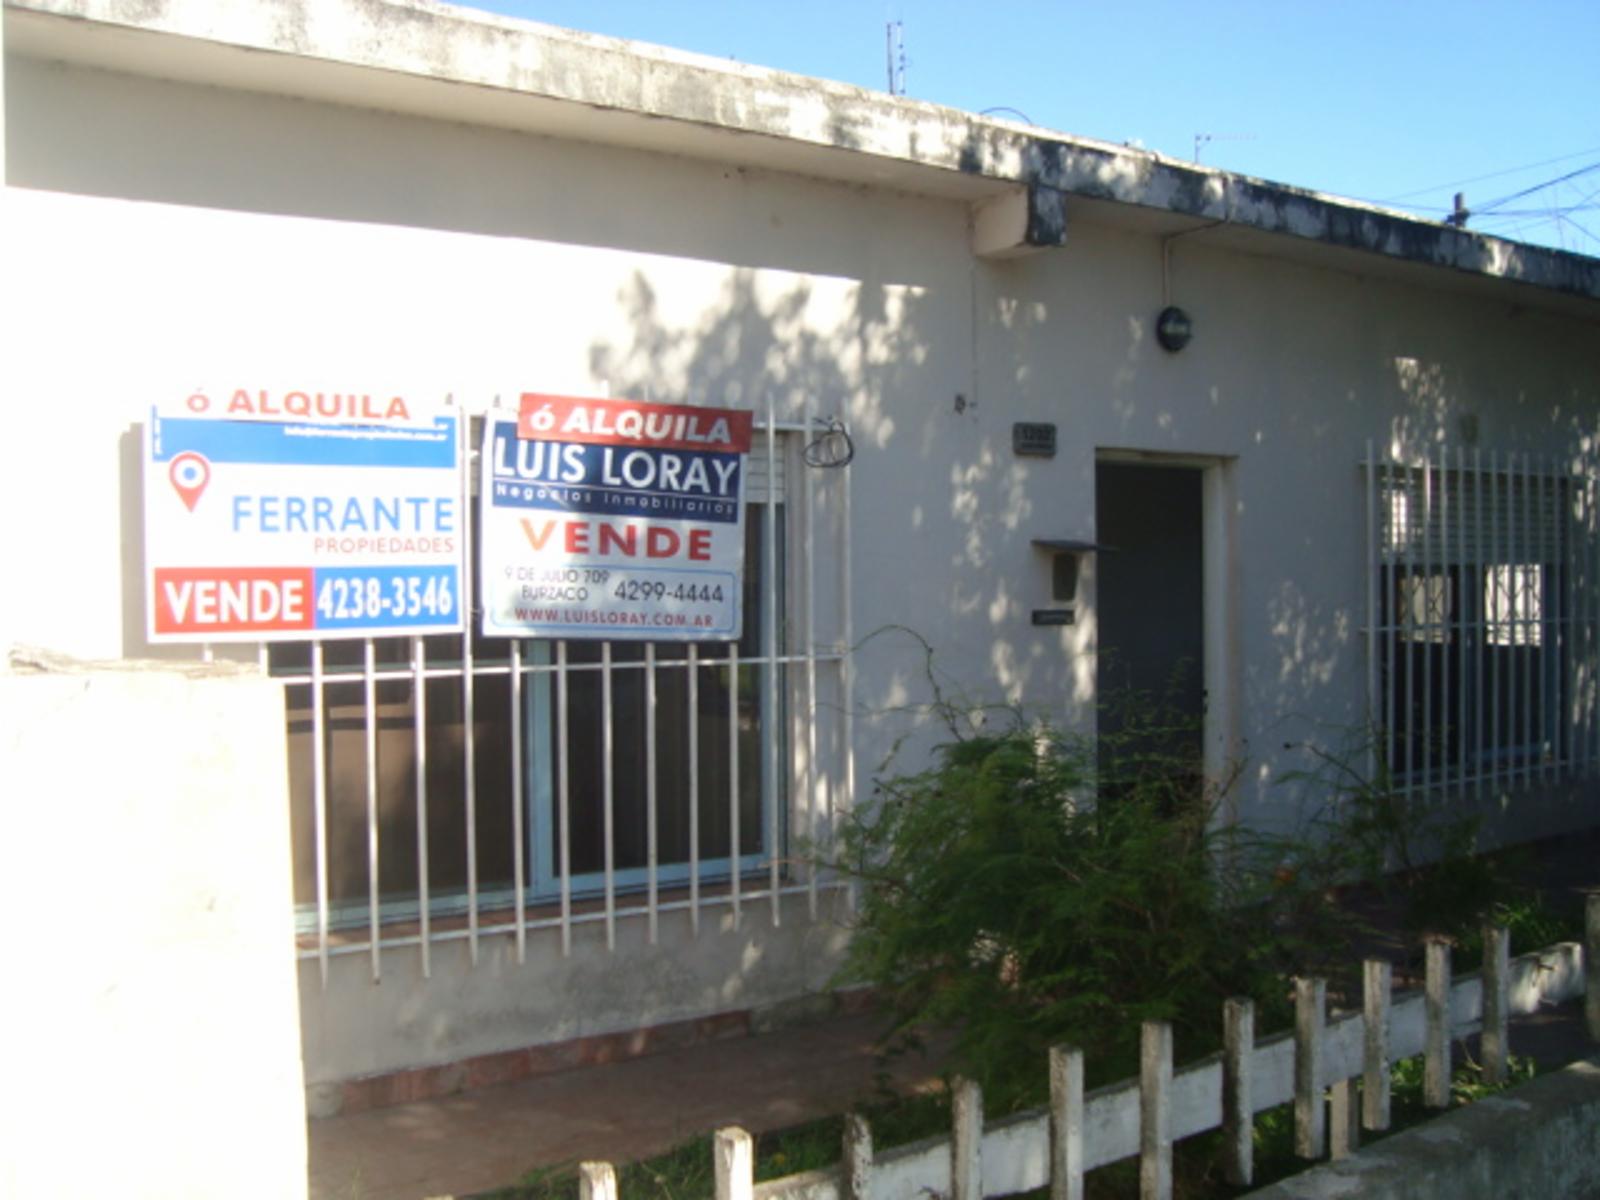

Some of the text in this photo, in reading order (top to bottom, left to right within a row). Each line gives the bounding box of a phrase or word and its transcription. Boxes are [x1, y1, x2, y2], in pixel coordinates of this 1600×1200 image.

[228, 390, 410, 420] ALQUILA
[561, 407, 731, 443] ALQUILA
[494, 437, 738, 495] LUIS LORAY
[496, 484, 592, 504] Negocios
[232, 496, 454, 532] FERRANTE
[315, 537, 454, 554] PROPIEDADES
[520, 518, 712, 561] VENDE
[517, 567, 535, 581] DE
[542, 569, 579, 584] JULIO
[584, 569, 610, 584] 709
[164, 576, 452, 624] VENDE 4238-3546
[522, 585, 588, 601] BURZACO
[614, 581, 724, 602] 4299-4444
[515, 607, 713, 627] WWW.LUISLORAY.COM.AR
